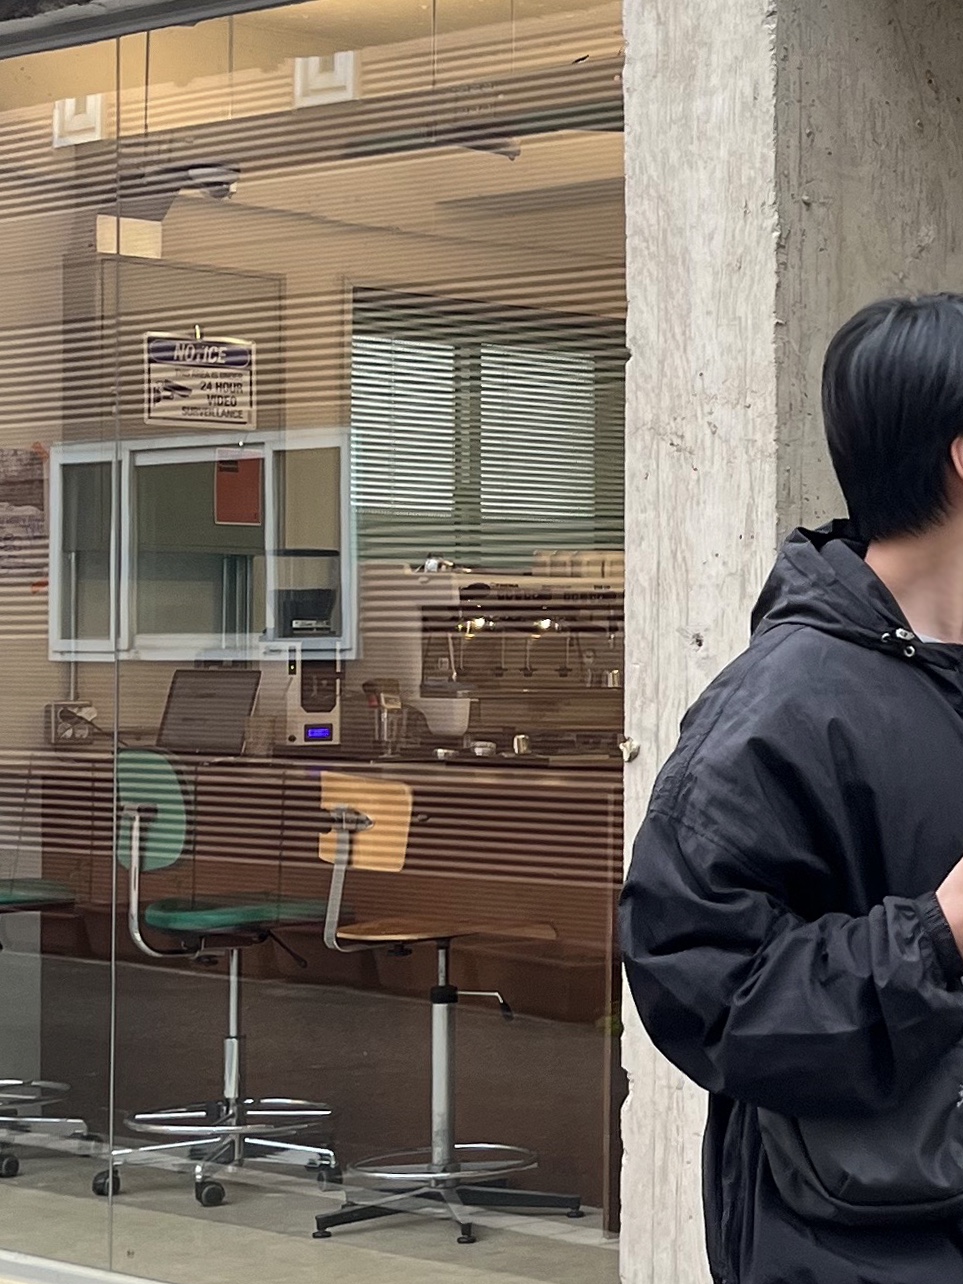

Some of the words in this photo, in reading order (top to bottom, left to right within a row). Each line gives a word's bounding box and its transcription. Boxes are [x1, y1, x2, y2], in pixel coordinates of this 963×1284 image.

[200, 381, 212, 391] 24
[215, 381, 244, 394] HOUR
[207, 394, 238, 407] VIDEO
